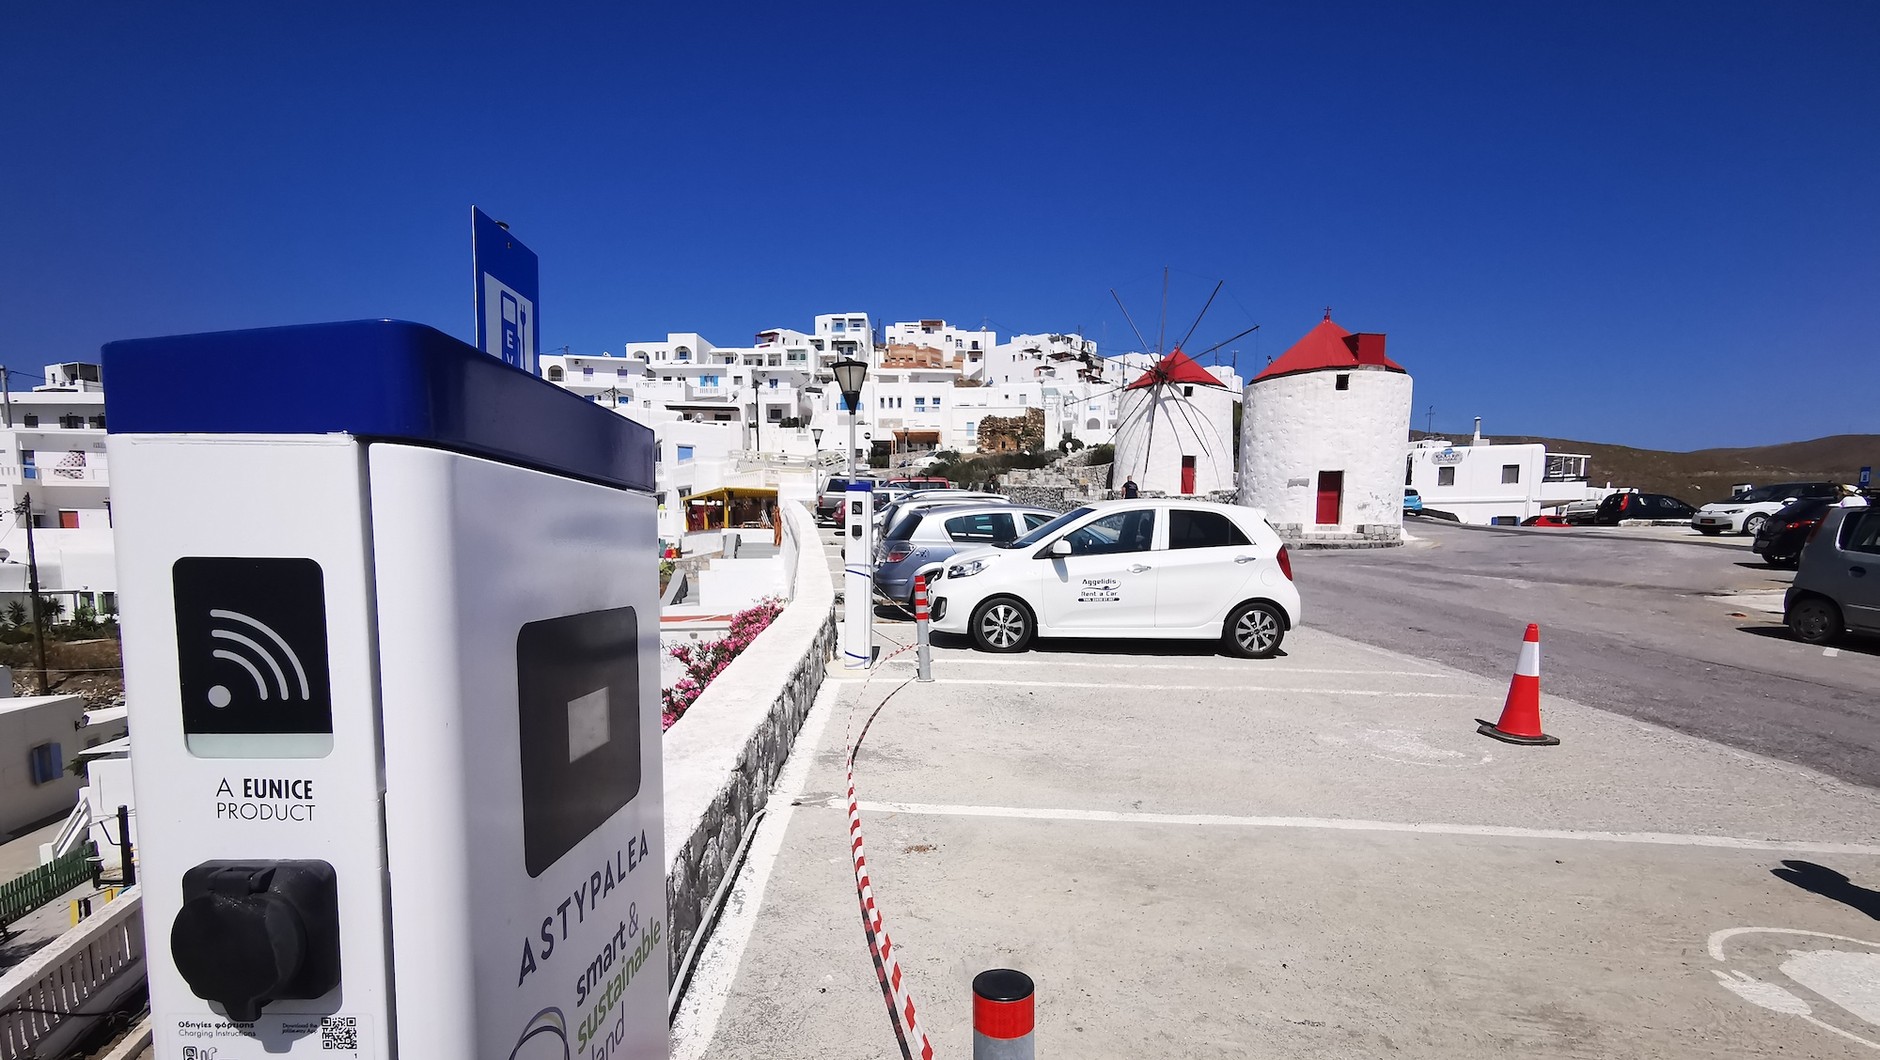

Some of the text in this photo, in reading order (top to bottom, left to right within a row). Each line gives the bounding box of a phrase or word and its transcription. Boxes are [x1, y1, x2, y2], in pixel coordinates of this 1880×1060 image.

[1082, 578, 1117, 586] Aggelidis
[216, 777, 313, 800] A EUNICE
[216, 802, 316, 822] PRODUCT
[518, 829, 649, 988] ASTYPALEA
[576, 901, 639, 1008] smart &
[577, 917, 661, 1055] sustainable
[178, 1029, 257, 1039] Charging Instructions
